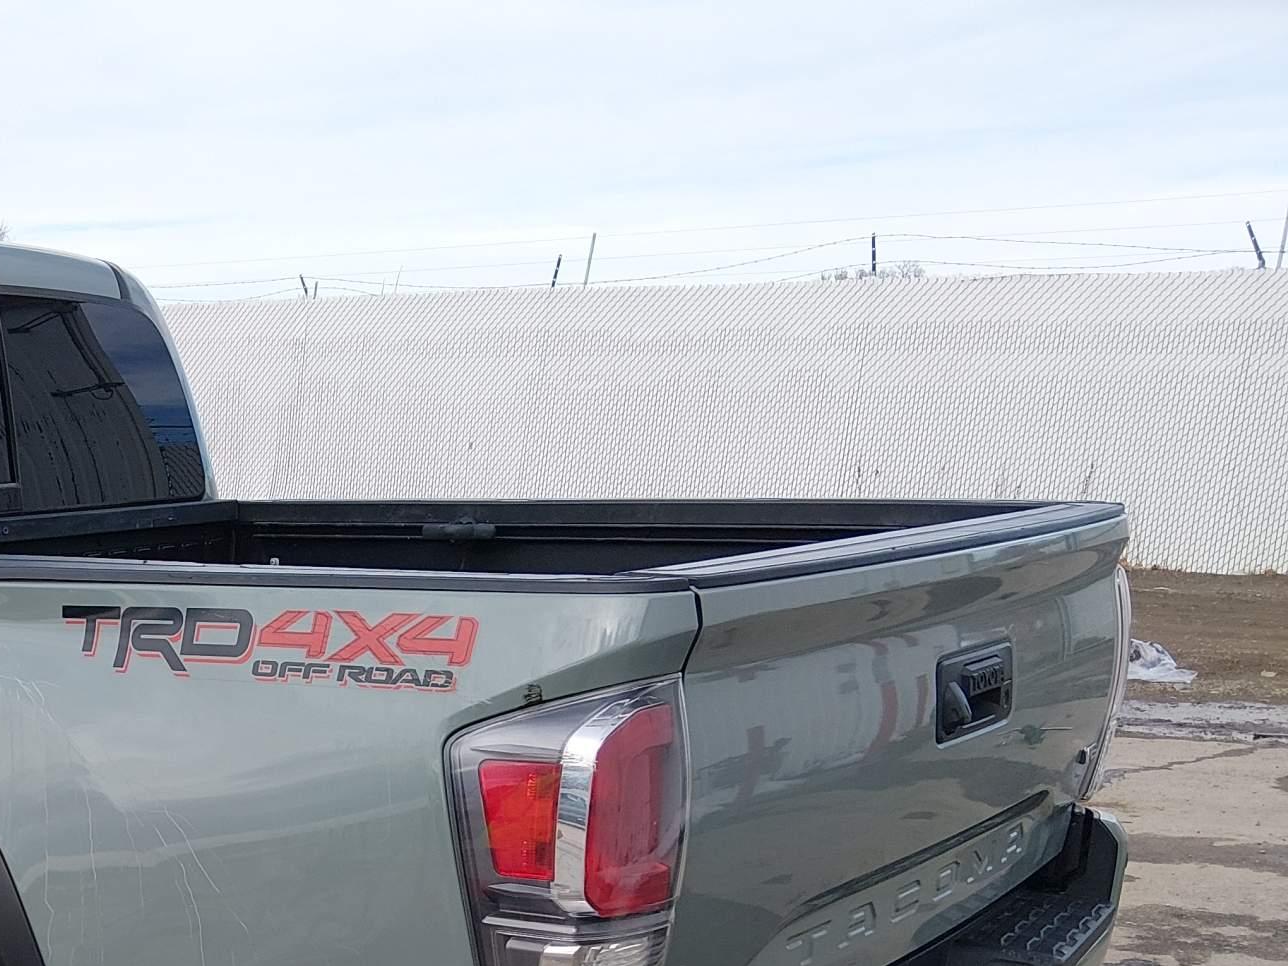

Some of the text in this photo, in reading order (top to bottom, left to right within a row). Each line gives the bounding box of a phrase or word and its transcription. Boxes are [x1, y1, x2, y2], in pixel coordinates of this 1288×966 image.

[62, 605, 257, 677] TRD
[251, 660, 457, 692] OFF ROAD
[786, 820, 1023, 966] TACOMA
